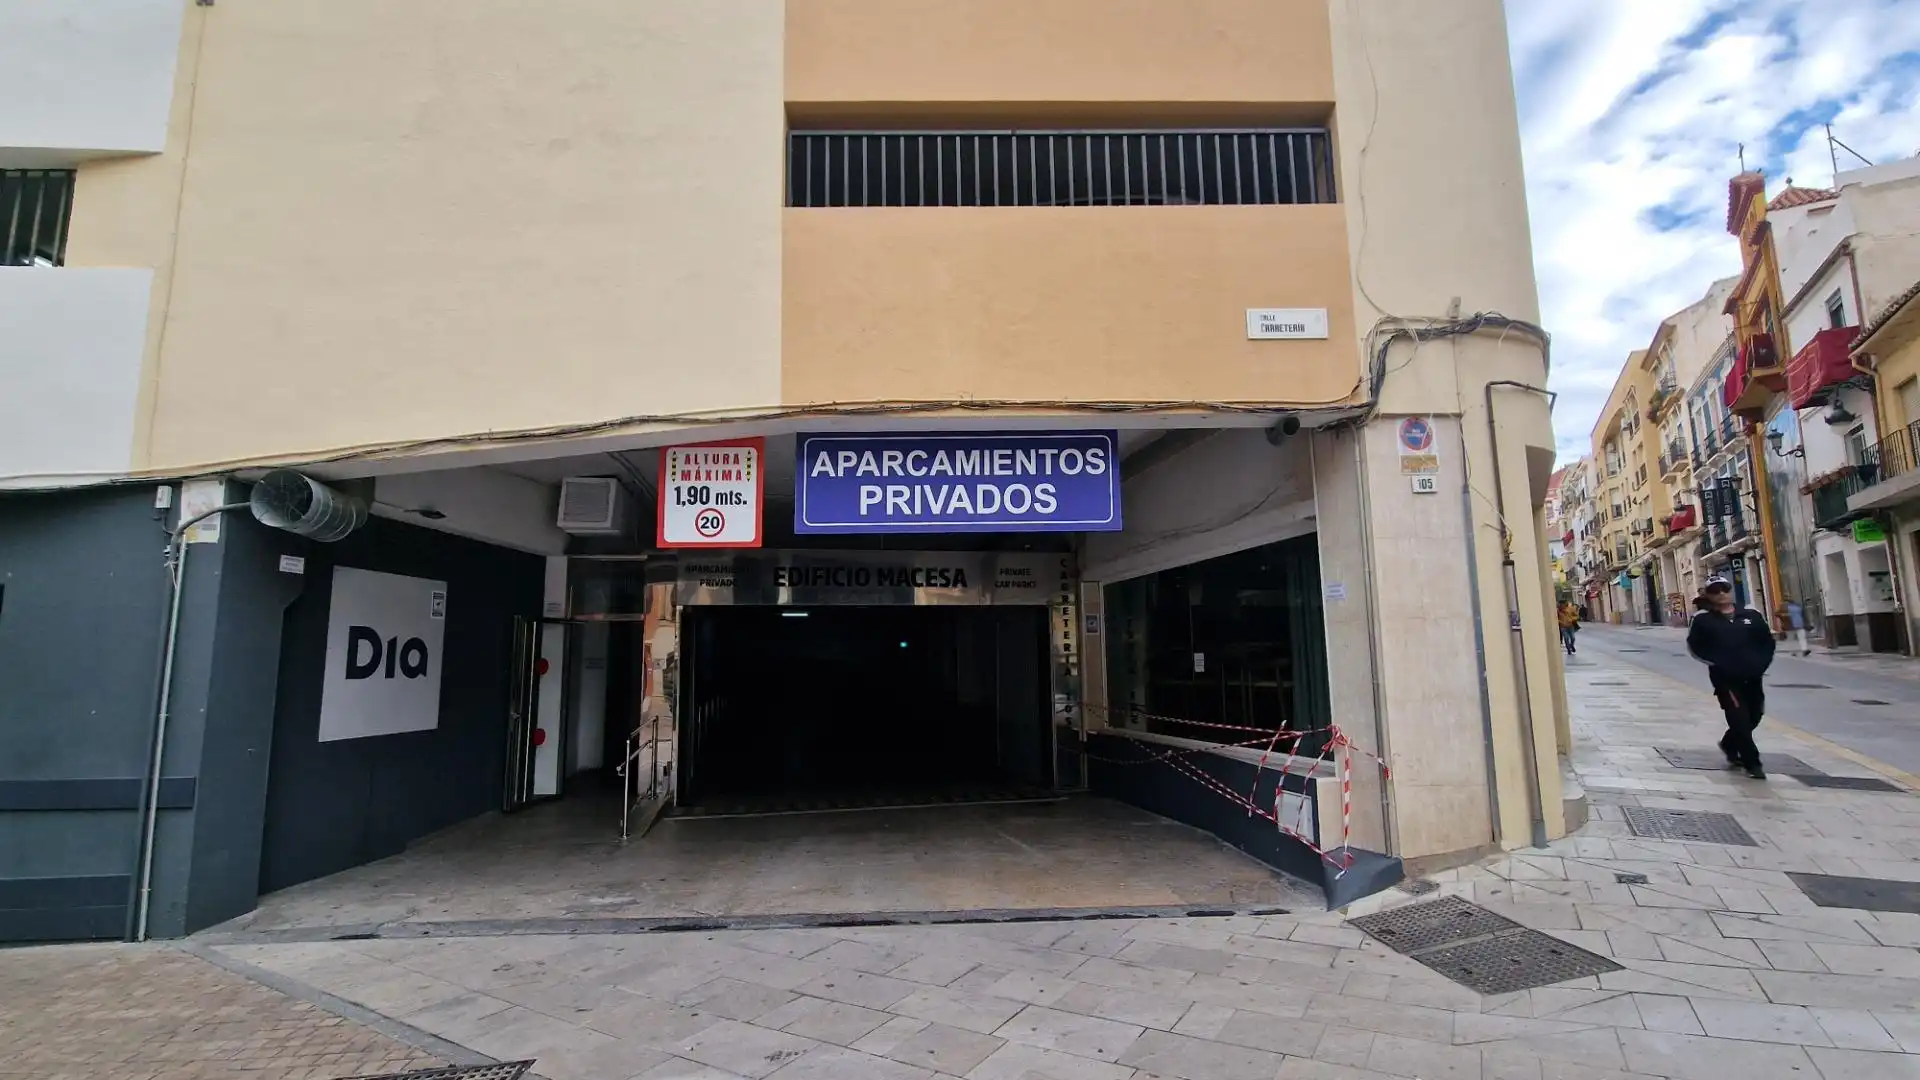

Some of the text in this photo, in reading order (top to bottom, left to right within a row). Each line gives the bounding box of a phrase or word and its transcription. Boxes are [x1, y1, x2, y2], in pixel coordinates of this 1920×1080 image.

[684, 453, 740, 465] ALTURA
[811, 448, 1106, 477] APARCAMIENTOS
[680, 467, 742, 481] MÁXIMA
[1417, 479, 1433, 490] 105
[674, 485, 748, 507] 1,90 mts.
[859, 483, 1058, 516] PRIVADOS
[700, 516, 720, 529] 20
[685, 564, 753, 574] APARCAMIEO
[1000, 568, 1032, 576] PRIVATE
[773, 566, 968, 588] EDIFICIO MACESA
